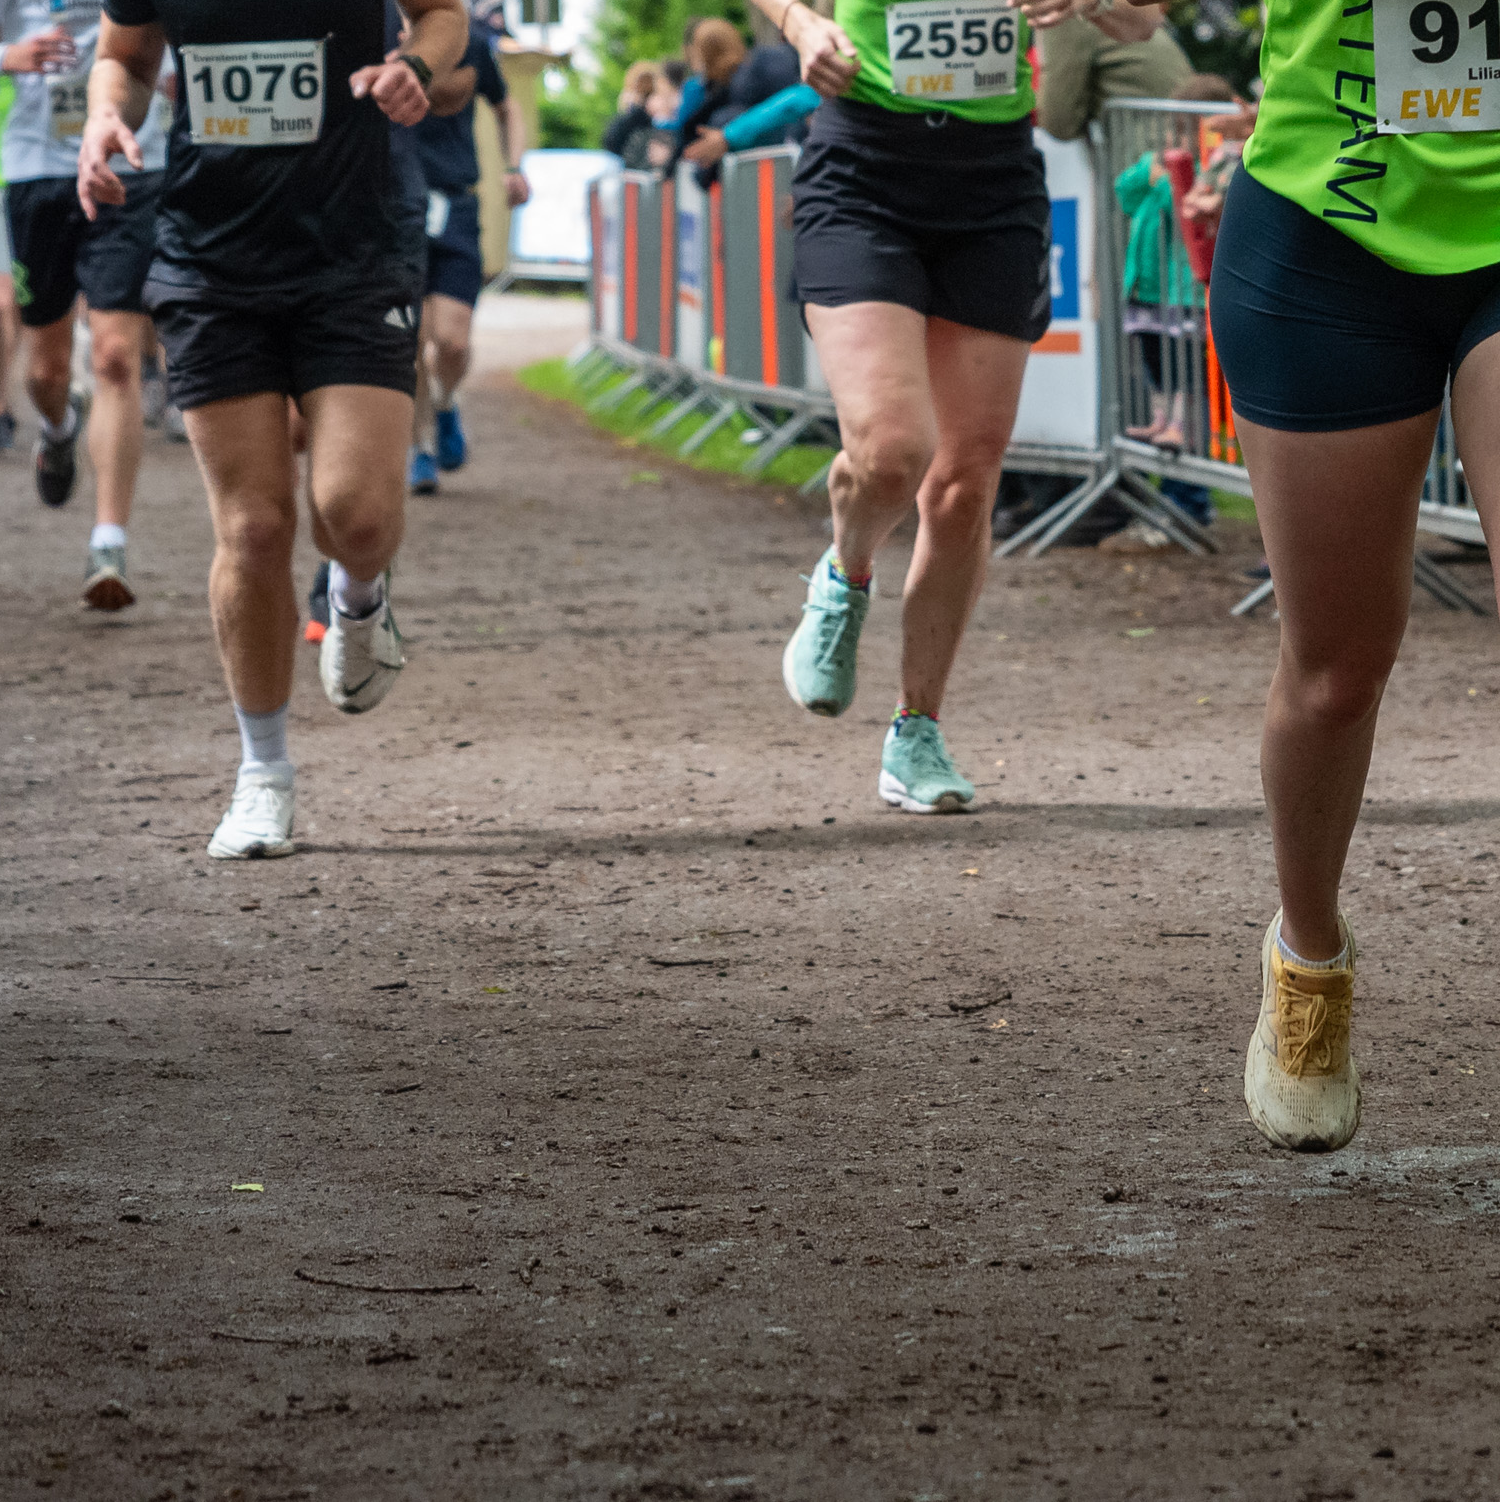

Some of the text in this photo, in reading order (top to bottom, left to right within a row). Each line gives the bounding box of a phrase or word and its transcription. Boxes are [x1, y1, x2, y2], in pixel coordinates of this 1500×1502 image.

[894, 17, 1014, 60] 2556
[193, 62, 319, 104] 1076
[905, 73, 955, 95] EWE
[1400, 87, 1483, 120] EWE
[204, 115, 313, 136] EWE bruns
